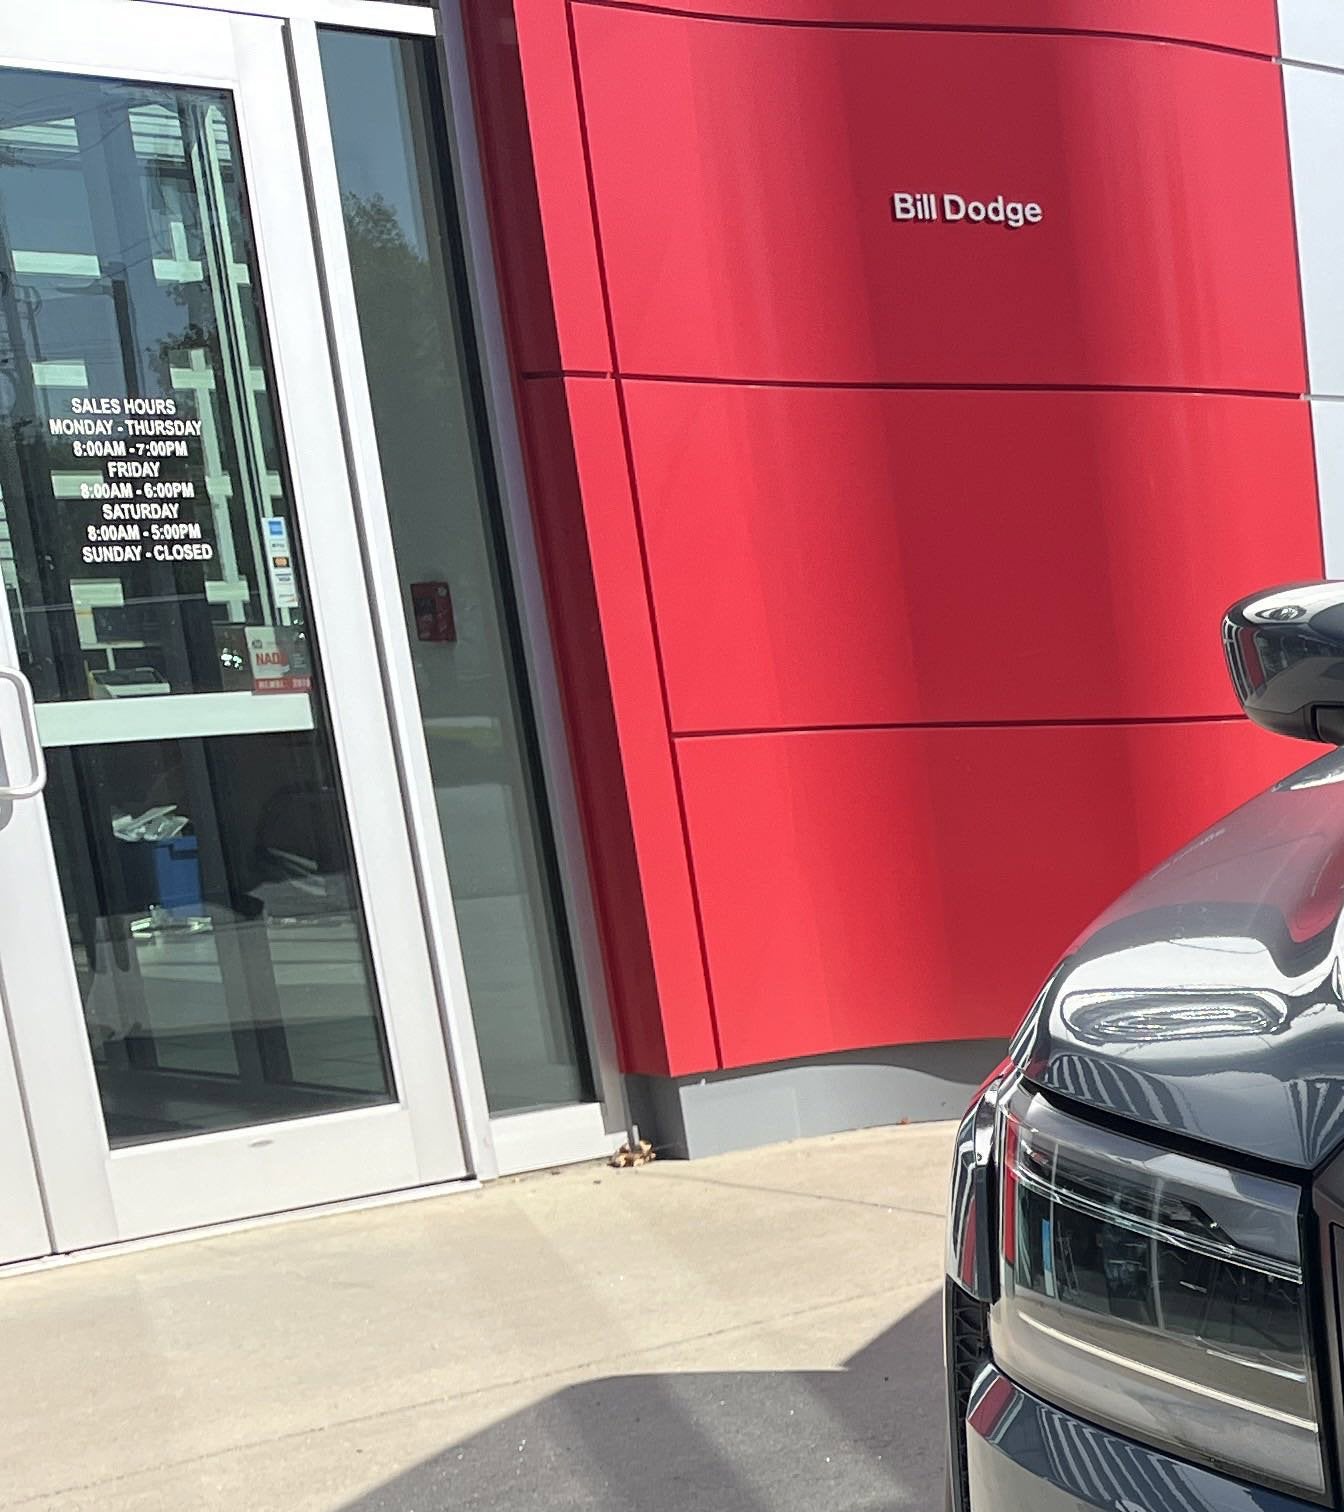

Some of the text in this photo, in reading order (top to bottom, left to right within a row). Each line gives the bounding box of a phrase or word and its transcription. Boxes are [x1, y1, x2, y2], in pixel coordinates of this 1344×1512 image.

[893, 192, 1043, 228] Bill Dodge
[71, 398, 176, 415] SALES HOURS
[49, 419, 113, 435] MONDAY
[124, 420, 202, 436] THURSDAY
[73, 441, 127, 457] 8:00AM
[107, 461, 160, 478] FRIDAY
[80, 483, 134, 499] 8:00AM
[143, 482, 195, 498] 6:00PM
[102, 503, 180, 520] SATURDAY
[87, 525, 141, 541] 8:00AM
[151, 523, 202, 540] 5:00PM
[82, 545, 142, 562] SUNDAY
[153, 543, 213, 560] CLOSED
